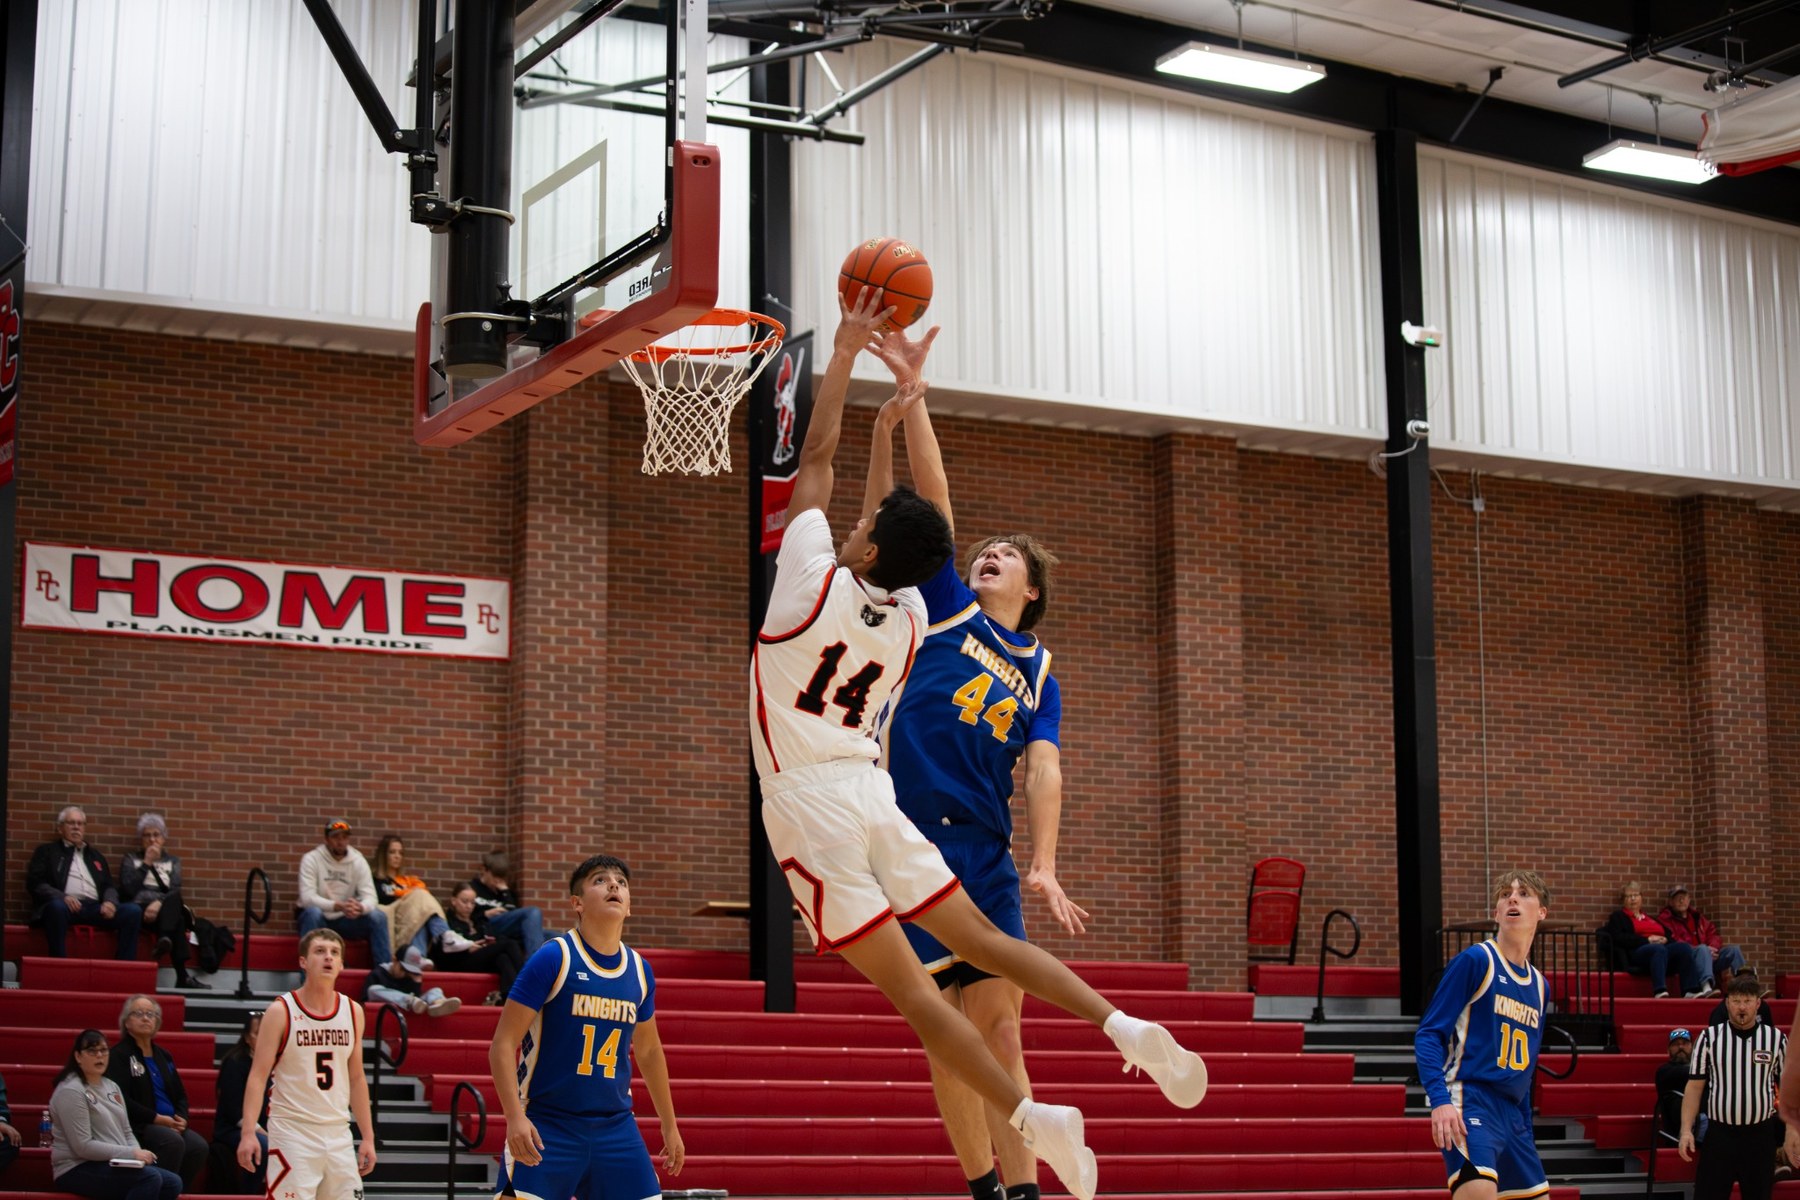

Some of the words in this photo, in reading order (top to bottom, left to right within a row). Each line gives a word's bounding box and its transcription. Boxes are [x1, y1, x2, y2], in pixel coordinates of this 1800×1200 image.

[70, 553, 467, 640] HOME
[106, 620, 320, 643] PLAINSMEN
[332, 637, 434, 651] PRIDE
[794, 640, 885, 729] 14
[960, 632, 1035, 711] KNIGHTS
[952, 671, 1020, 744] 44
[571, 993, 638, 1025] KNIGHTS
[1494, 993, 1540, 1029] KNIGHTS
[296, 1029, 350, 1047] CRAWFORD
[576, 1024, 623, 1080] 14
[1497, 1022, 1530, 1072] 10
[315, 1051, 334, 1091] 5
